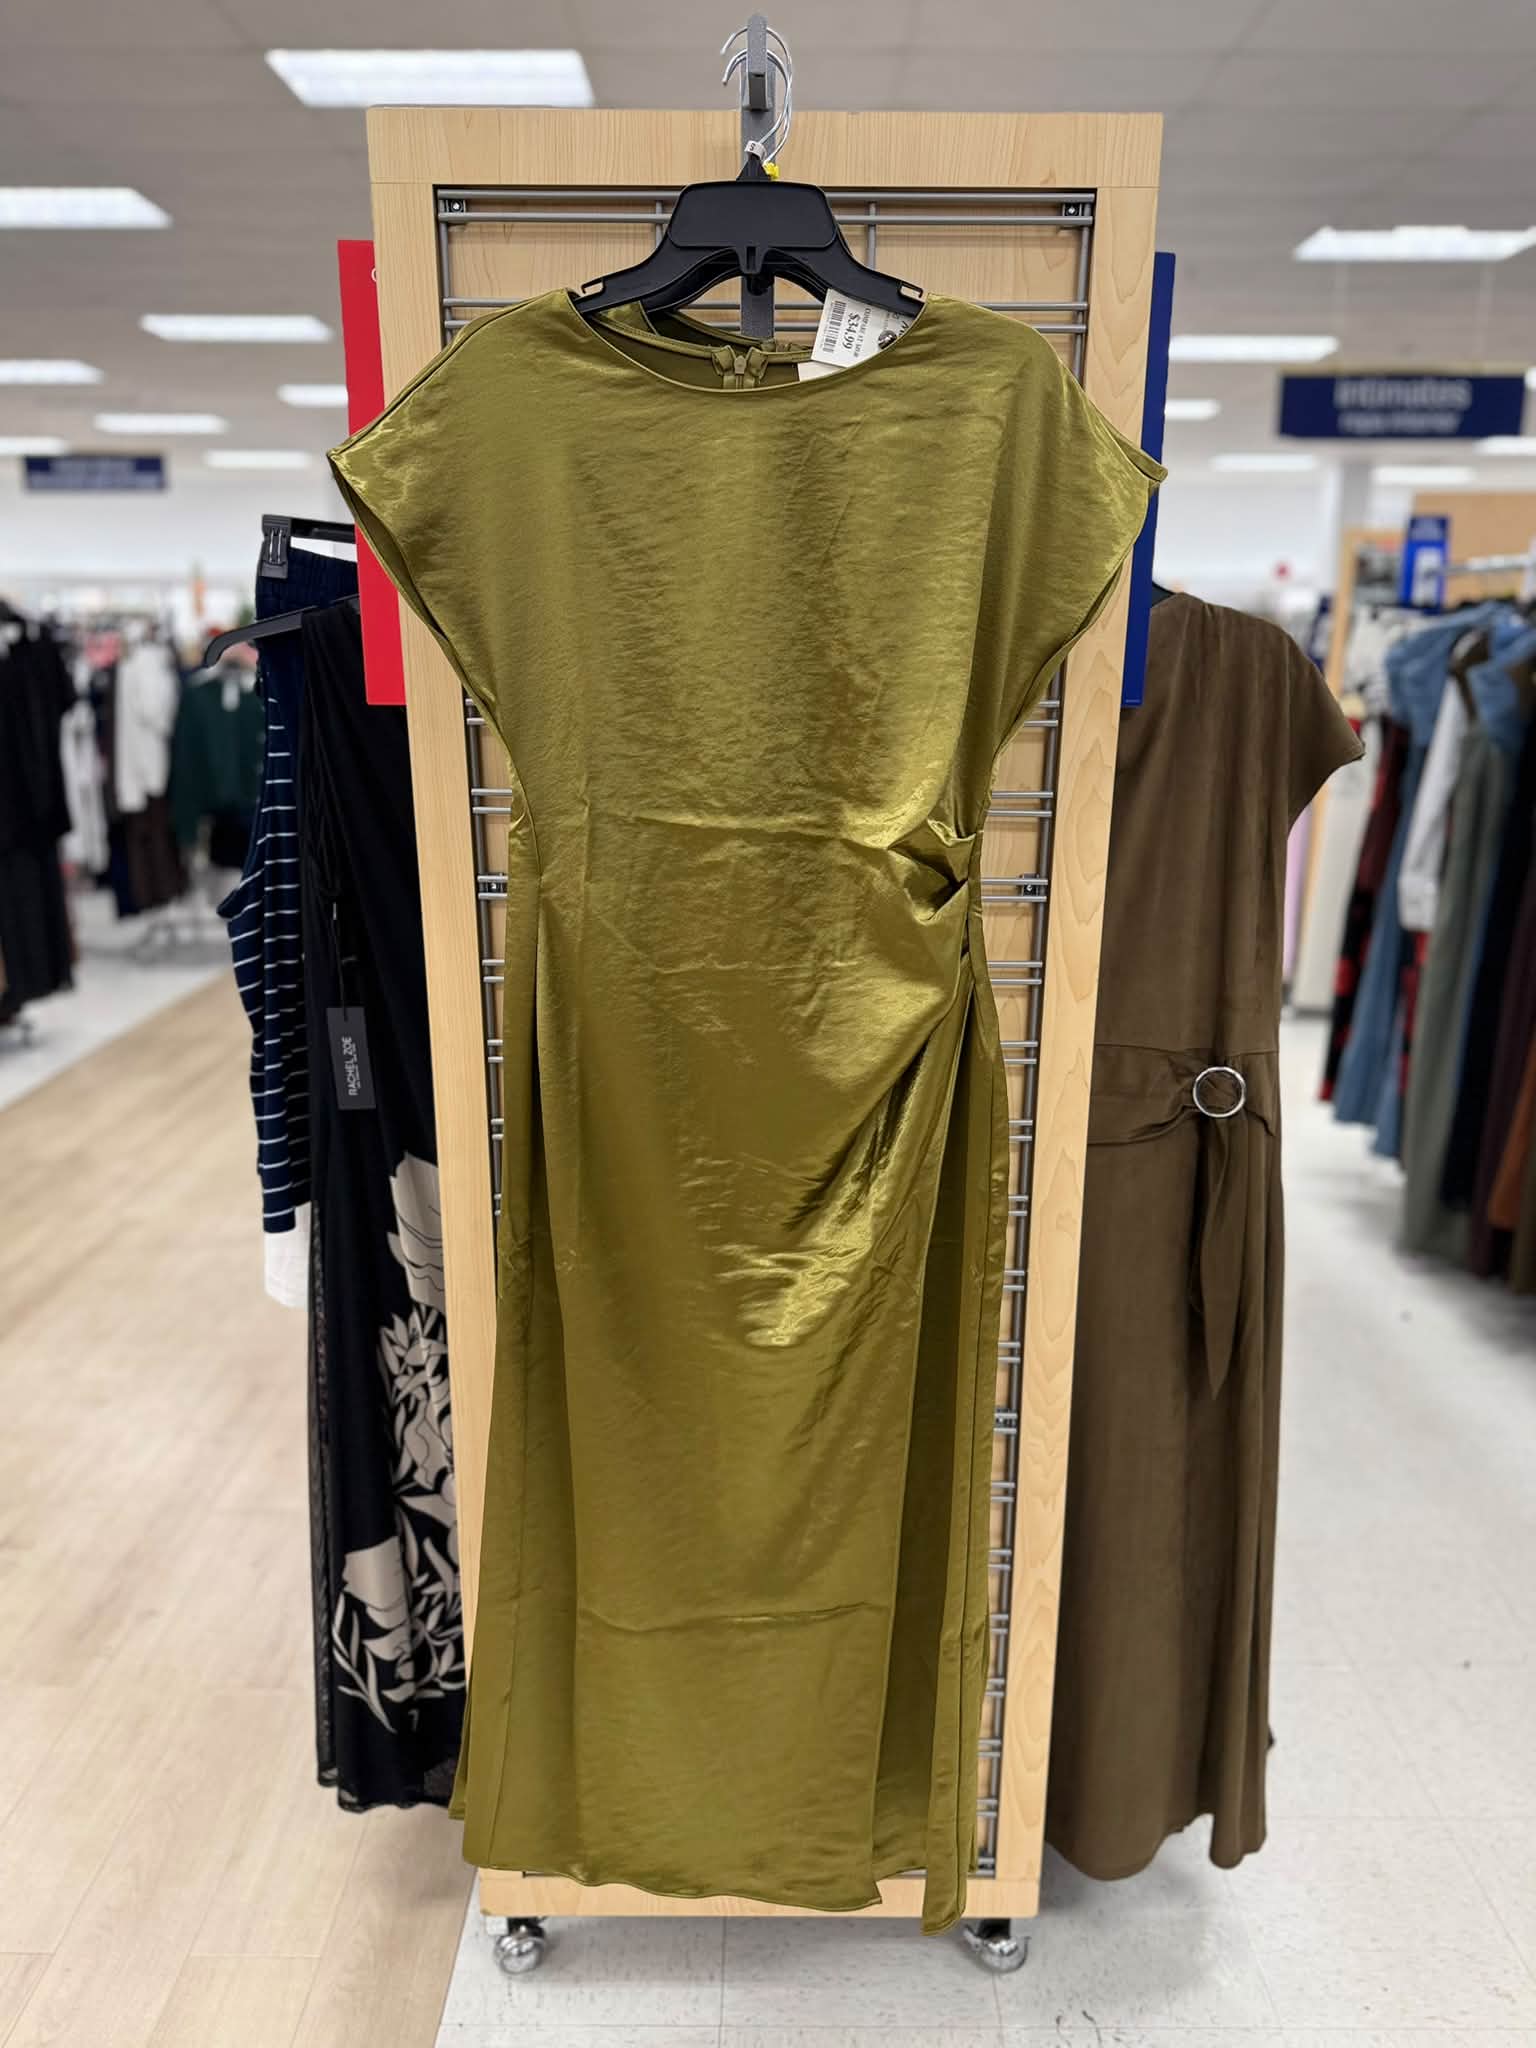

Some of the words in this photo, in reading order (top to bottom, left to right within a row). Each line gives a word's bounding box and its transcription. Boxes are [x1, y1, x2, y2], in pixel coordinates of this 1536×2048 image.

[842, 312, 861, 350] $34.99
[341, 1035, 353, 1055] ZOE
[344, 1059, 359, 1096] RACHEL
